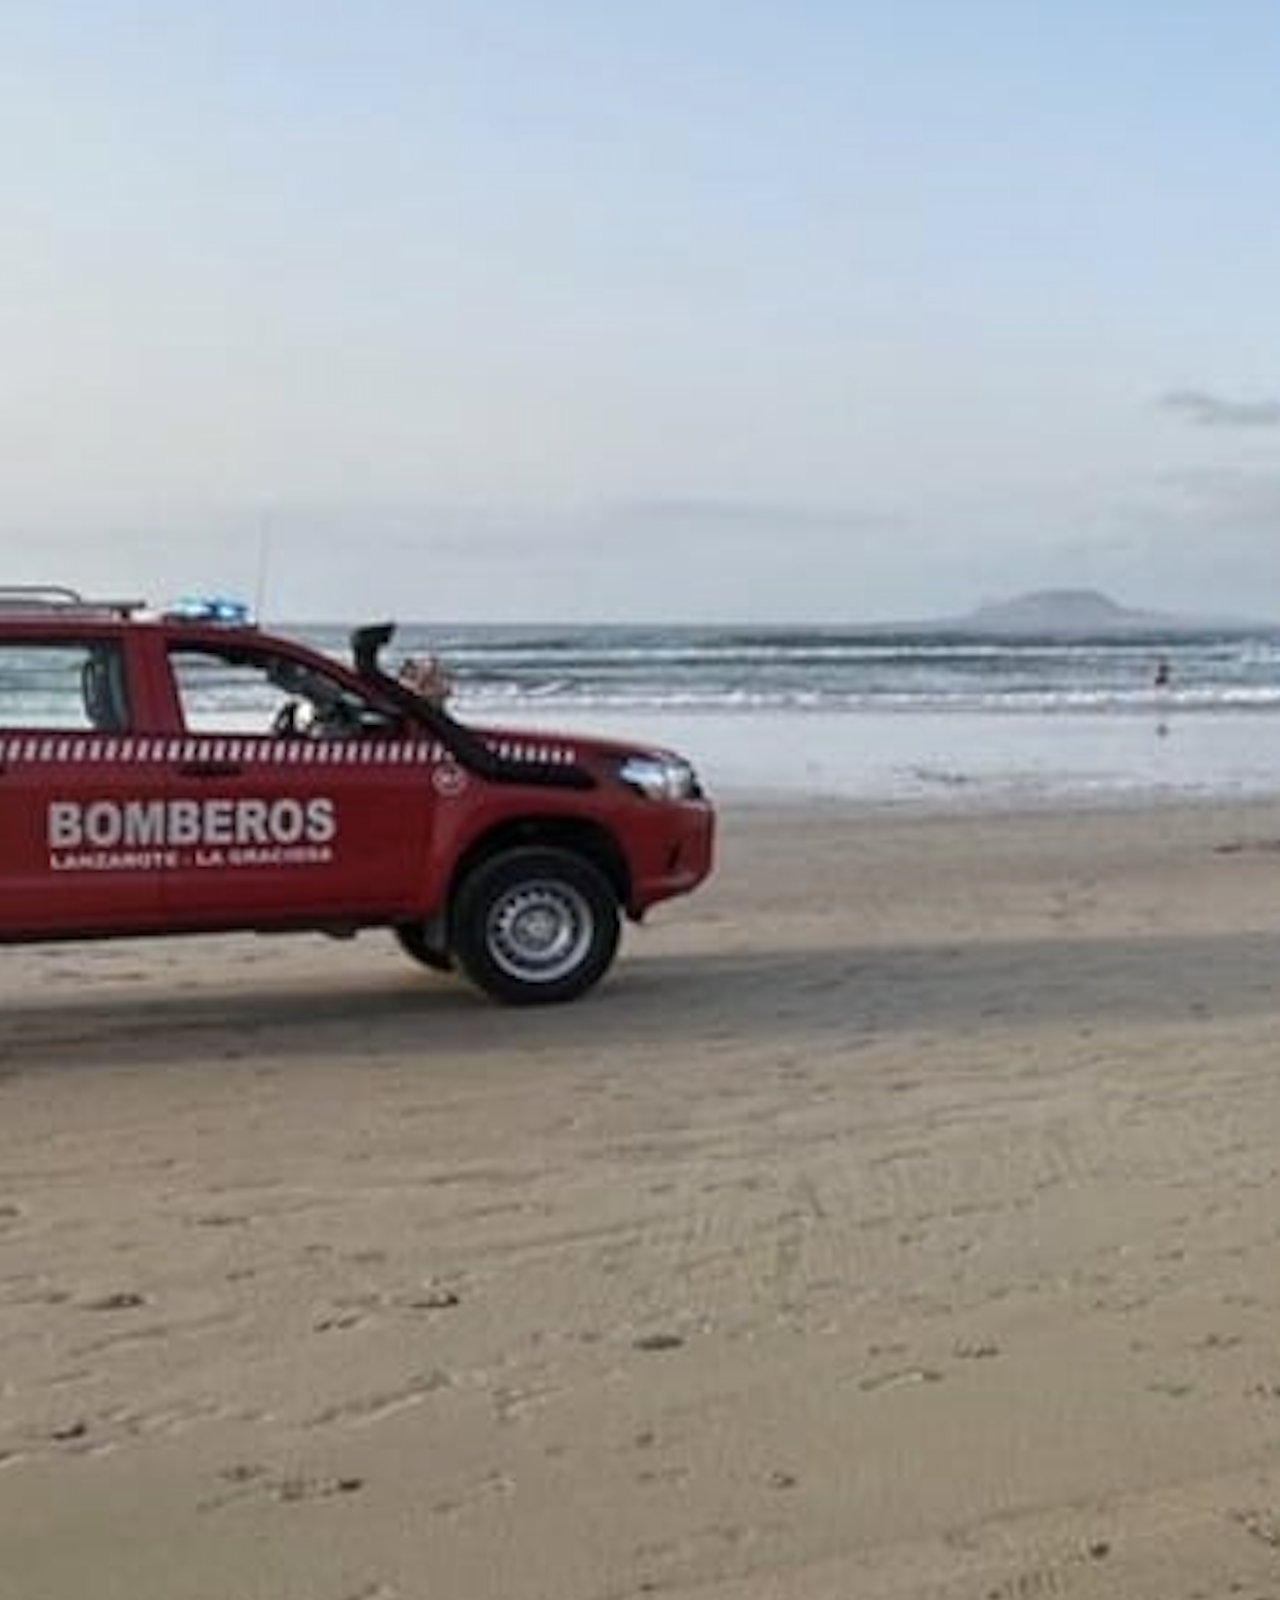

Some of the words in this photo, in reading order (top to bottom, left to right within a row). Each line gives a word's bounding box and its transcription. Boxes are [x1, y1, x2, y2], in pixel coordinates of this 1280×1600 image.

[48, 799, 336, 847] BOMBEROS
[49, 850, 177, 870] LANZAROTE
[195, 849, 224, 867] LA
[228, 846, 333, 865] GRACIOSA
